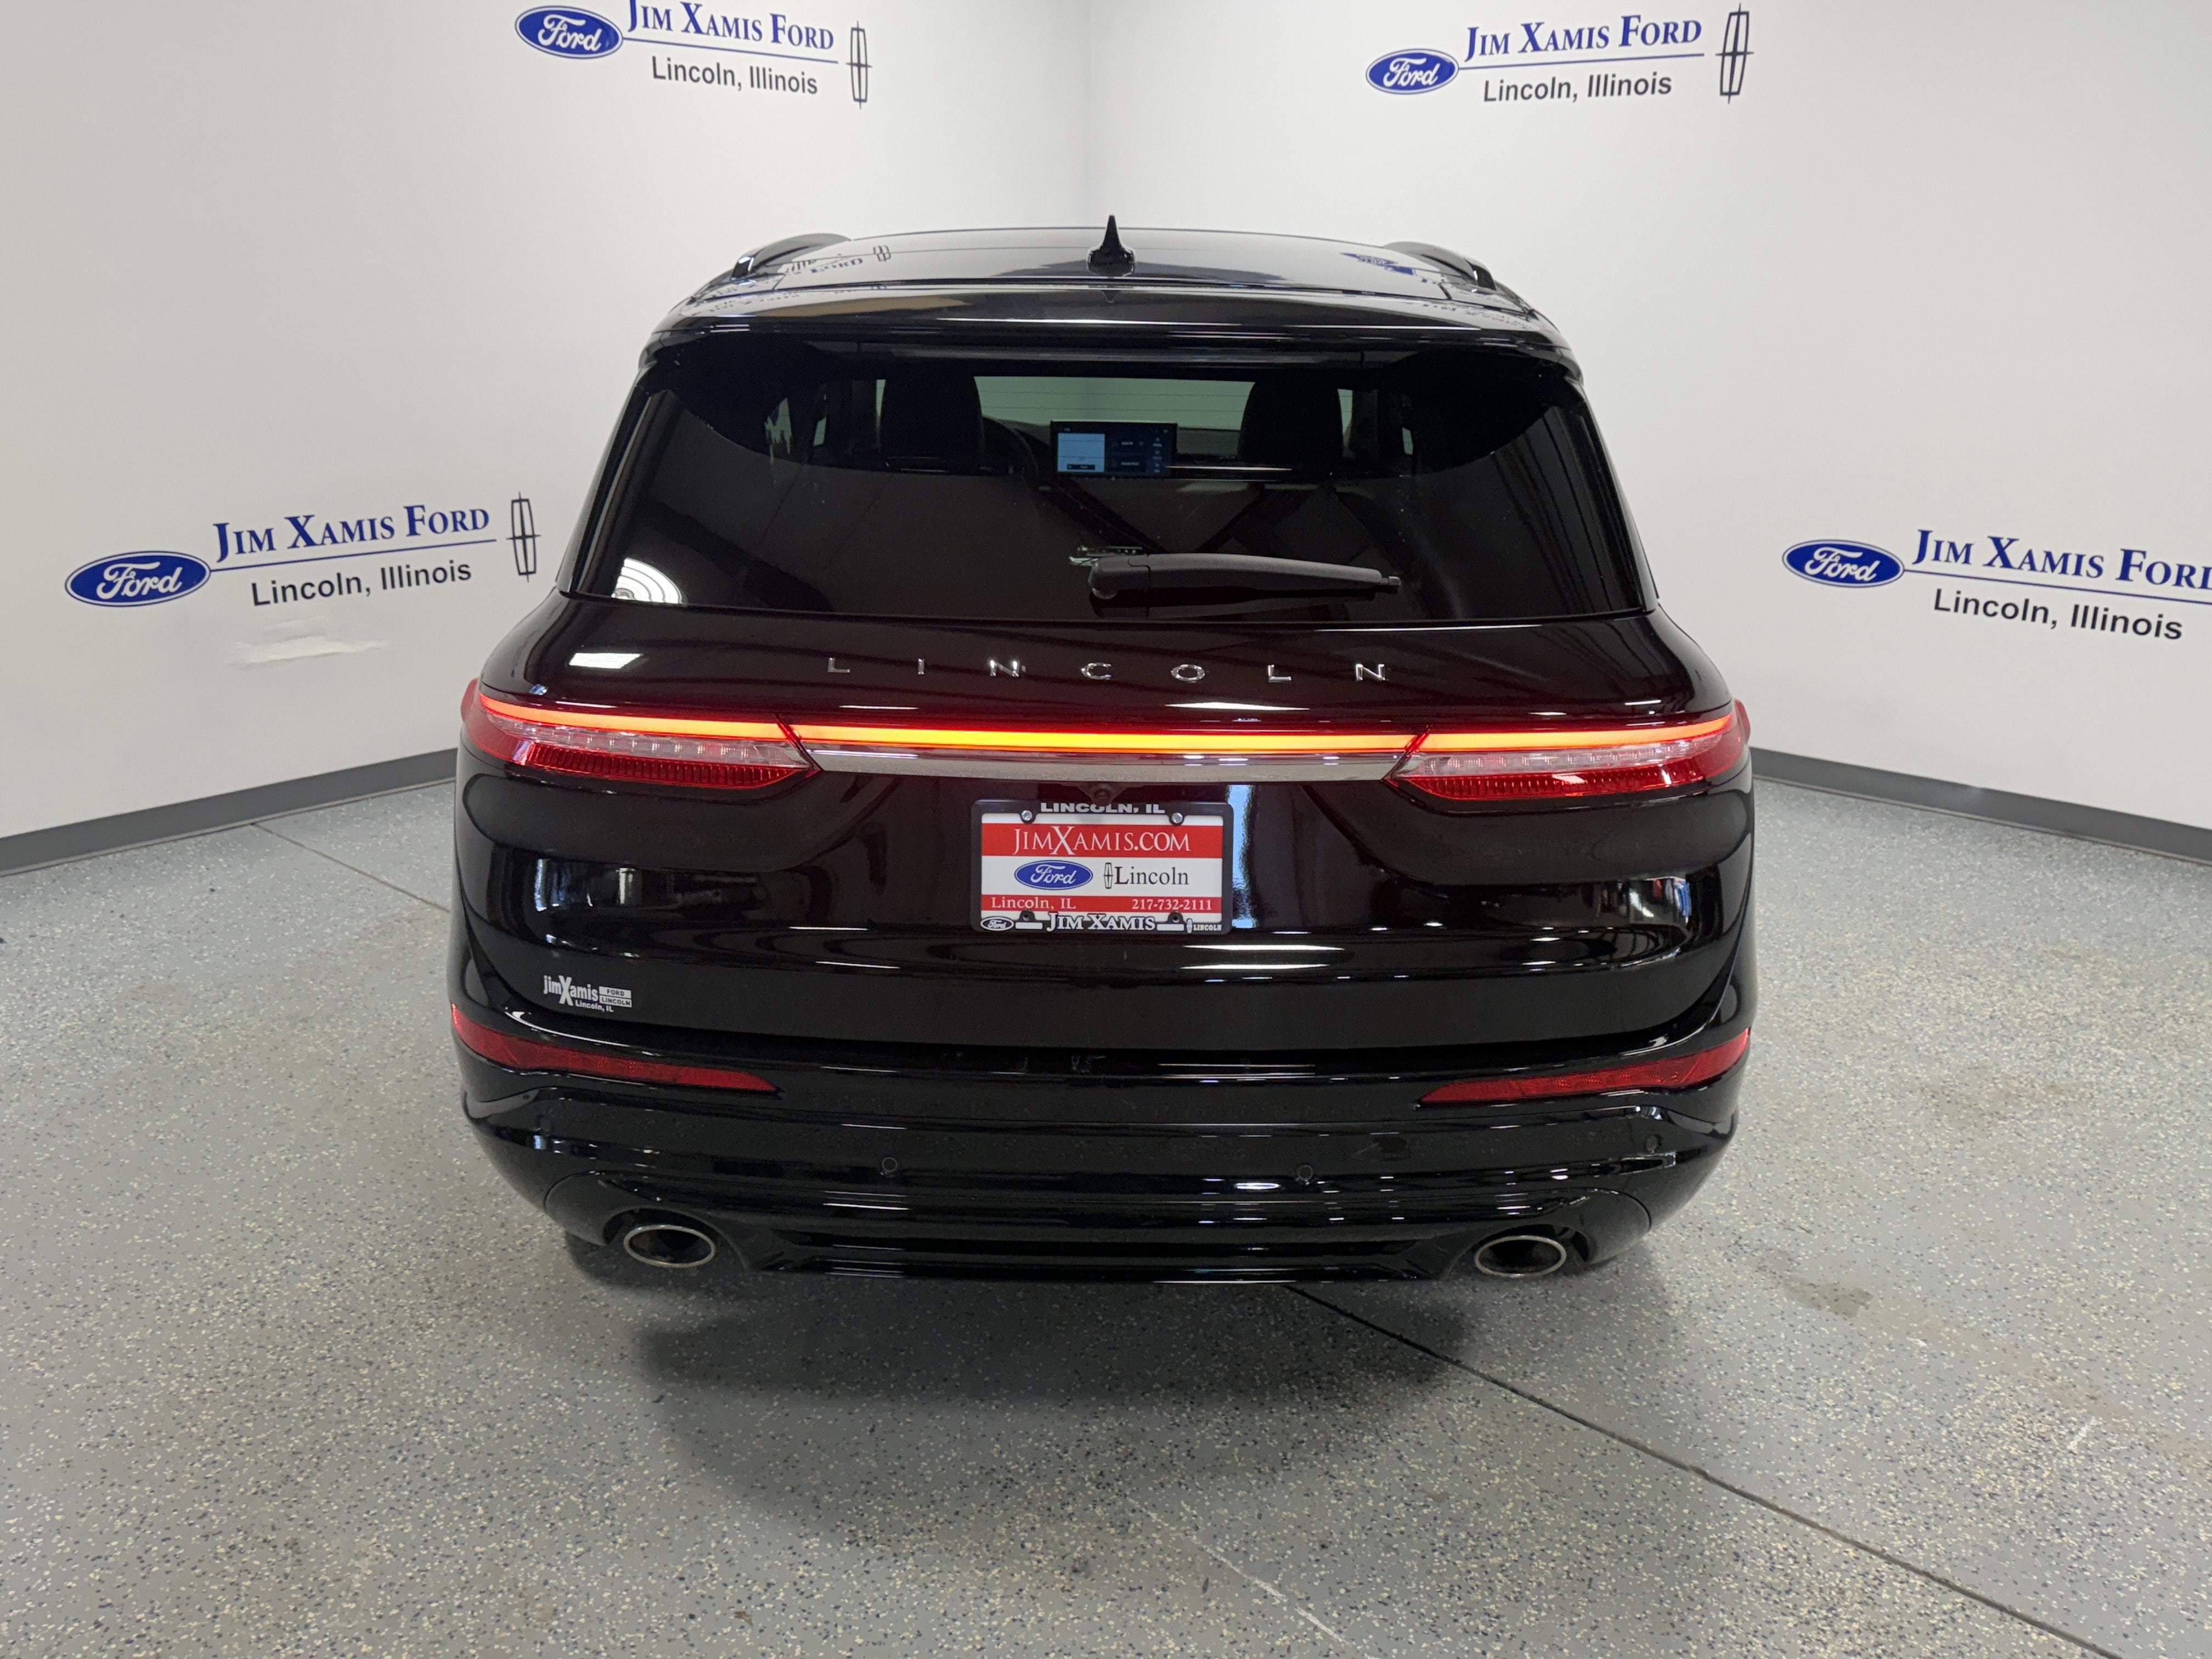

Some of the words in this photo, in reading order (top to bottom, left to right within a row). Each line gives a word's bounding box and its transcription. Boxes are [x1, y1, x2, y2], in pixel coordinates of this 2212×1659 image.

[538, 13, 601, 53] Ford
[628, 0, 673, 32] JIM
[680, 1, 763, 42] XAMIS
[770, 13, 834, 49] FORD
[1464, 27, 1510, 63] JIM
[1518, 22, 1609, 53] XAMIS
[1618, 15, 1702, 47] FORD
[652, 56, 741, 91] Lincoln,
[749, 66, 817, 94] Illinois
[1383, 58, 1438, 88] Ford
[1484, 76, 1577, 103] Lincoln,
[1588, 71, 1672, 97] Illinois
[213, 522, 276, 562] JIM
[284, 515, 395, 549] XAMIS
[403, 505, 489, 537] FORD
[1804, 546, 1877, 583] Ford
[1912, 529, 1973, 565] JIM
[1983, 536, 2104, 578] XAMIS
[95, 563, 183, 601] Ford
[251, 572, 370, 606] Lincoln,
[381, 560, 471, 590] Illinois
[1934, 589, 2058, 629] Lincoln,
[2071, 604, 2182, 640] Illinois
[828, 658, 1386, 681] LINCOLN
[1146, 804, 1165, 814] IL
[1030, 864, 1077, 884] Ford
[1114, 866, 1189, 885] Lincoln
[991, 896, 1054, 911] Lincoln,
[1060, 898, 1076, 909] IL
[1132, 899, 1212, 910] 217-732-2111
[987, 919, 1007, 929] Ford
[1046, 912, 1084, 932] JIM
[1087, 914, 1156, 930] XAMIS
[575, 999, 606, 1012] Lincoln,
[602, 997, 630, 1006] LINCOLN
